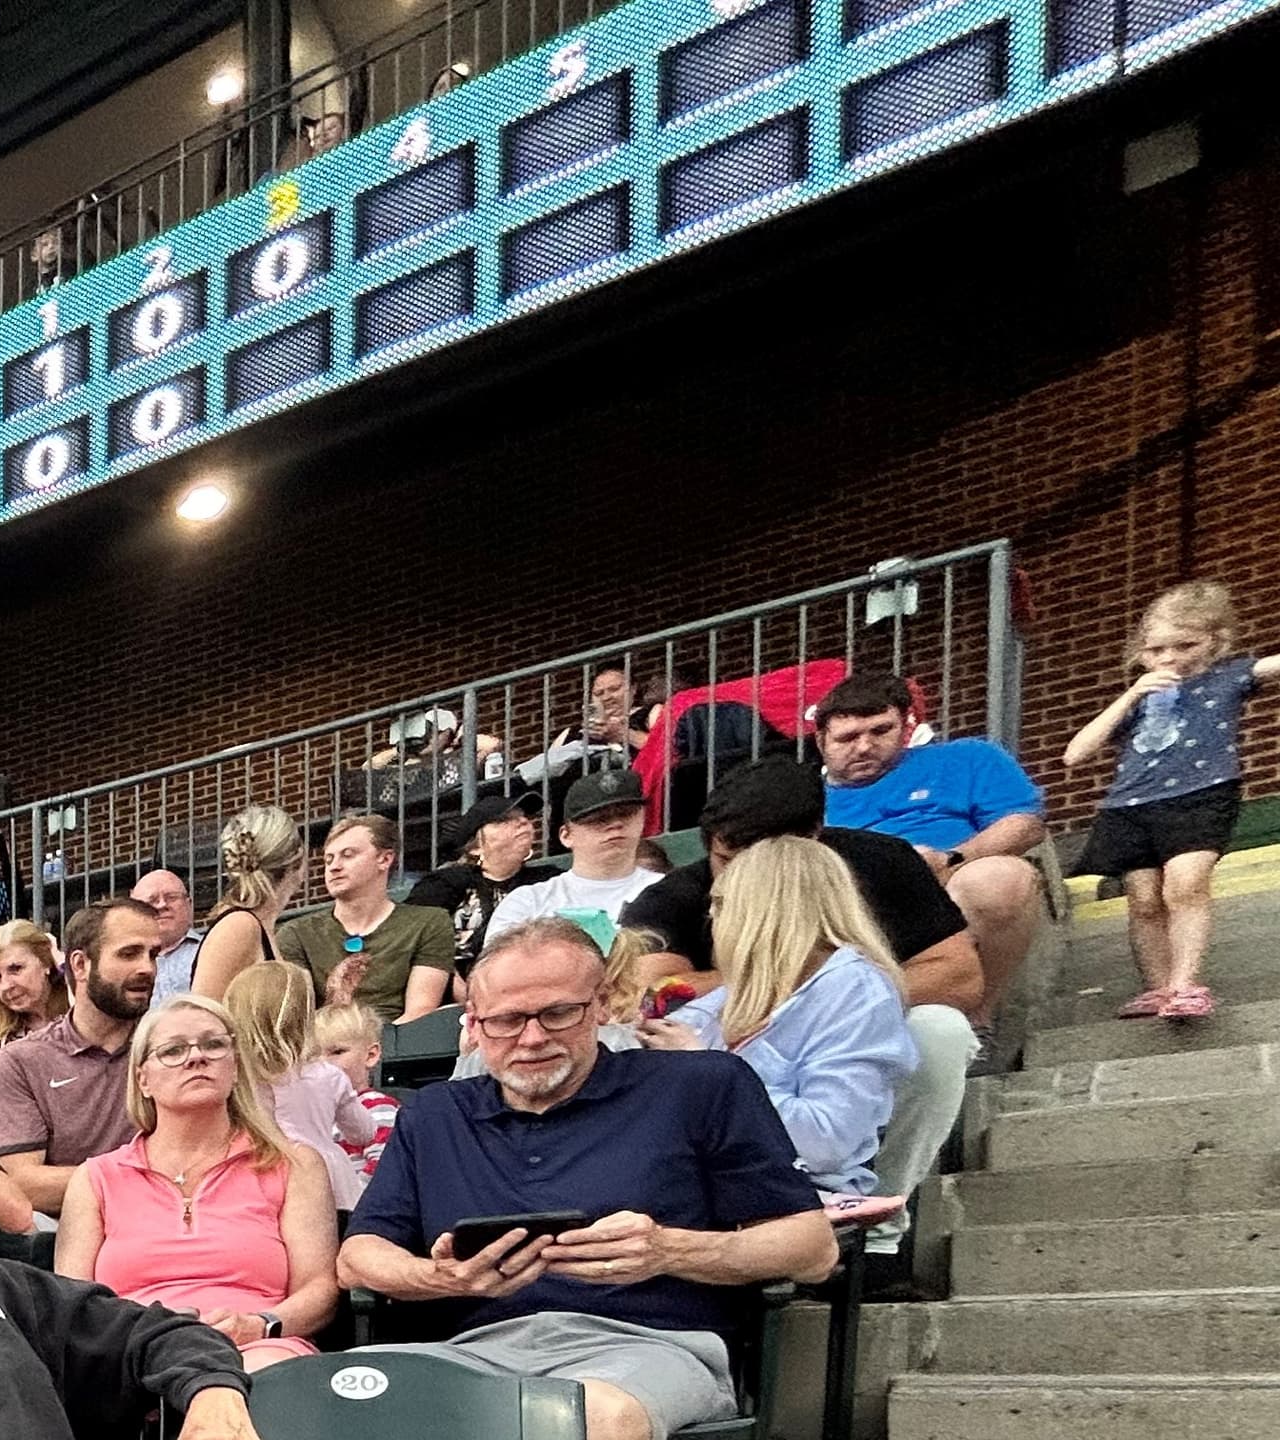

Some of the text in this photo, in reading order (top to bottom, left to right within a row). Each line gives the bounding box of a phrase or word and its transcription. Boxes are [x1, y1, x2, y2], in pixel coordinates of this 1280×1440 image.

[142, 247, 173, 289] 2
[33, 343, 66, 398] 1
[133, 292, 185, 352] 0
[251, 232, 309, 298] 0
[23, 432, 70, 489] 0
[132, 385, 183, 445] 0
[340, 1374, 379, 1392] 20
